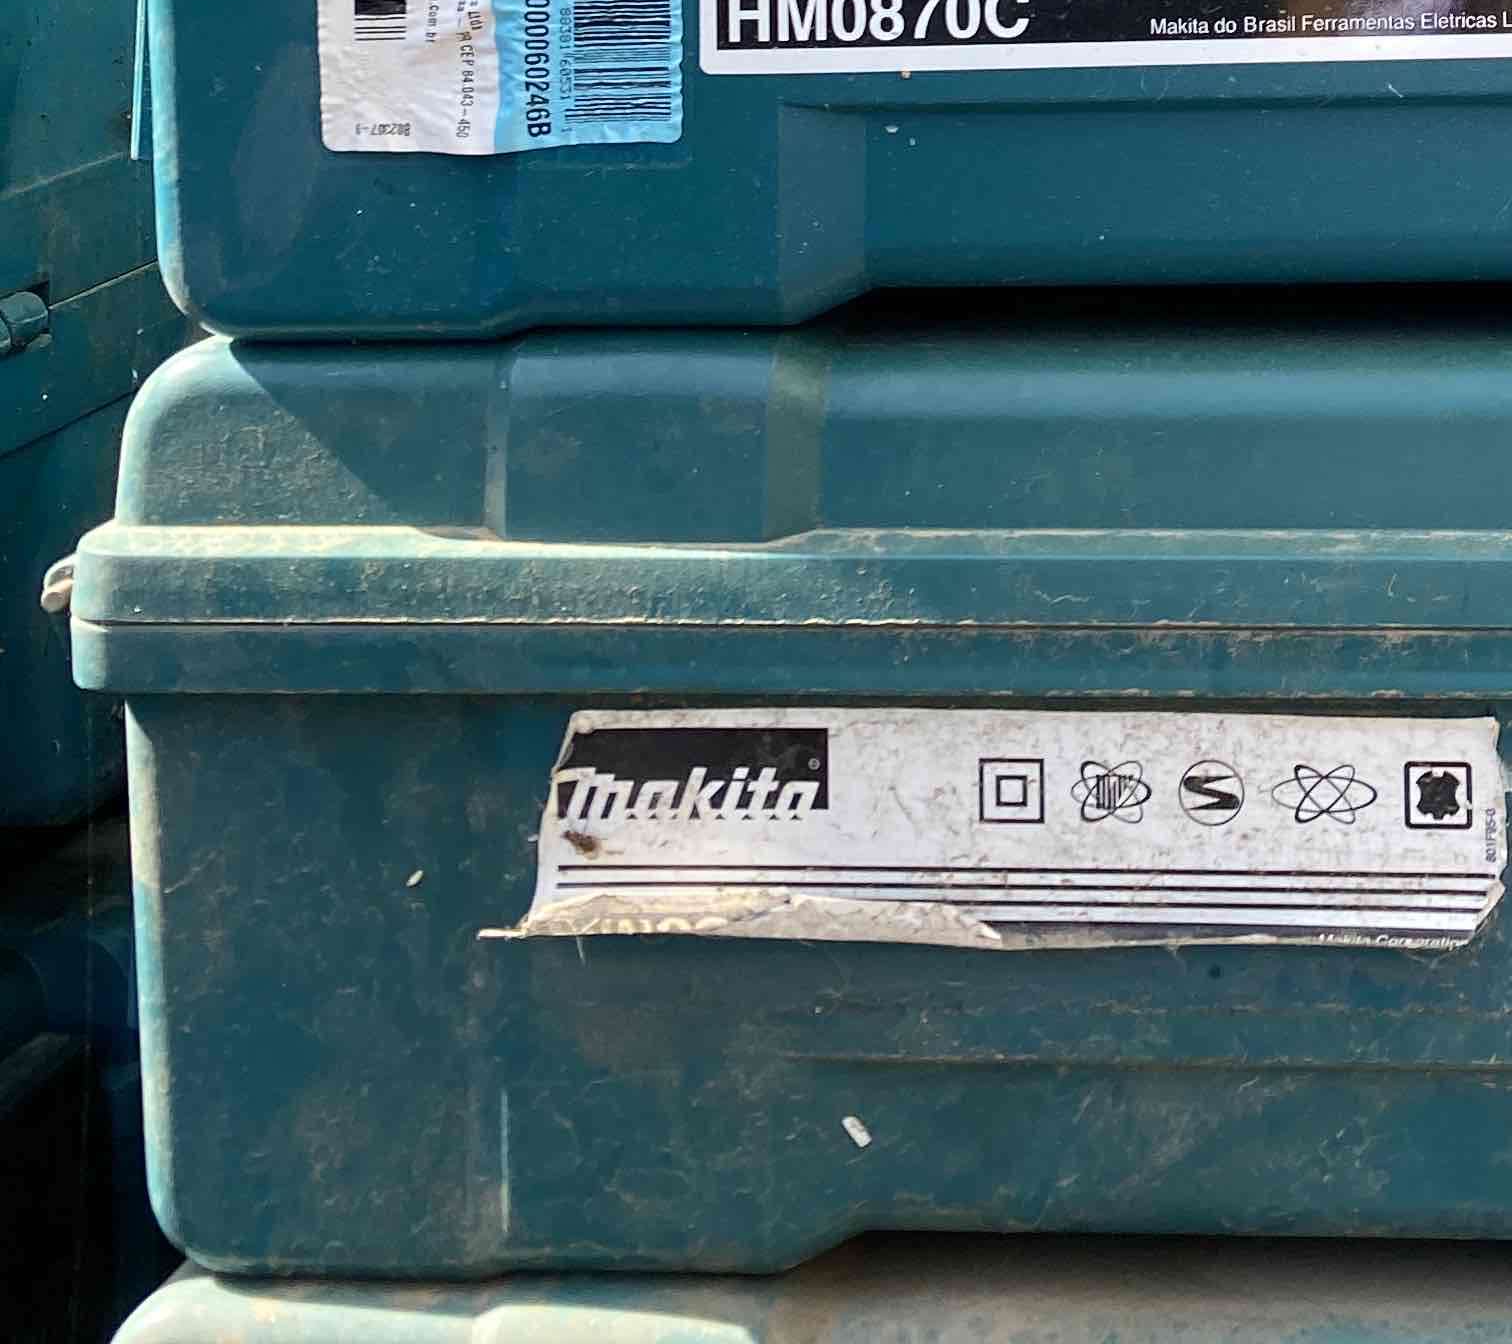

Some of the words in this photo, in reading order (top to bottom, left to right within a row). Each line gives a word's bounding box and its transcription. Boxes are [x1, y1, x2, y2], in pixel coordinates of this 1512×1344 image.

[1150, 15, 1210, 36] Makita
[1214, 15, 1237, 35] do
[1243, 13, 1297, 34] Brasil
[1300, 12, 1416, 33] Ferramentas
[1420, 11, 1498, 31] Eletricas
